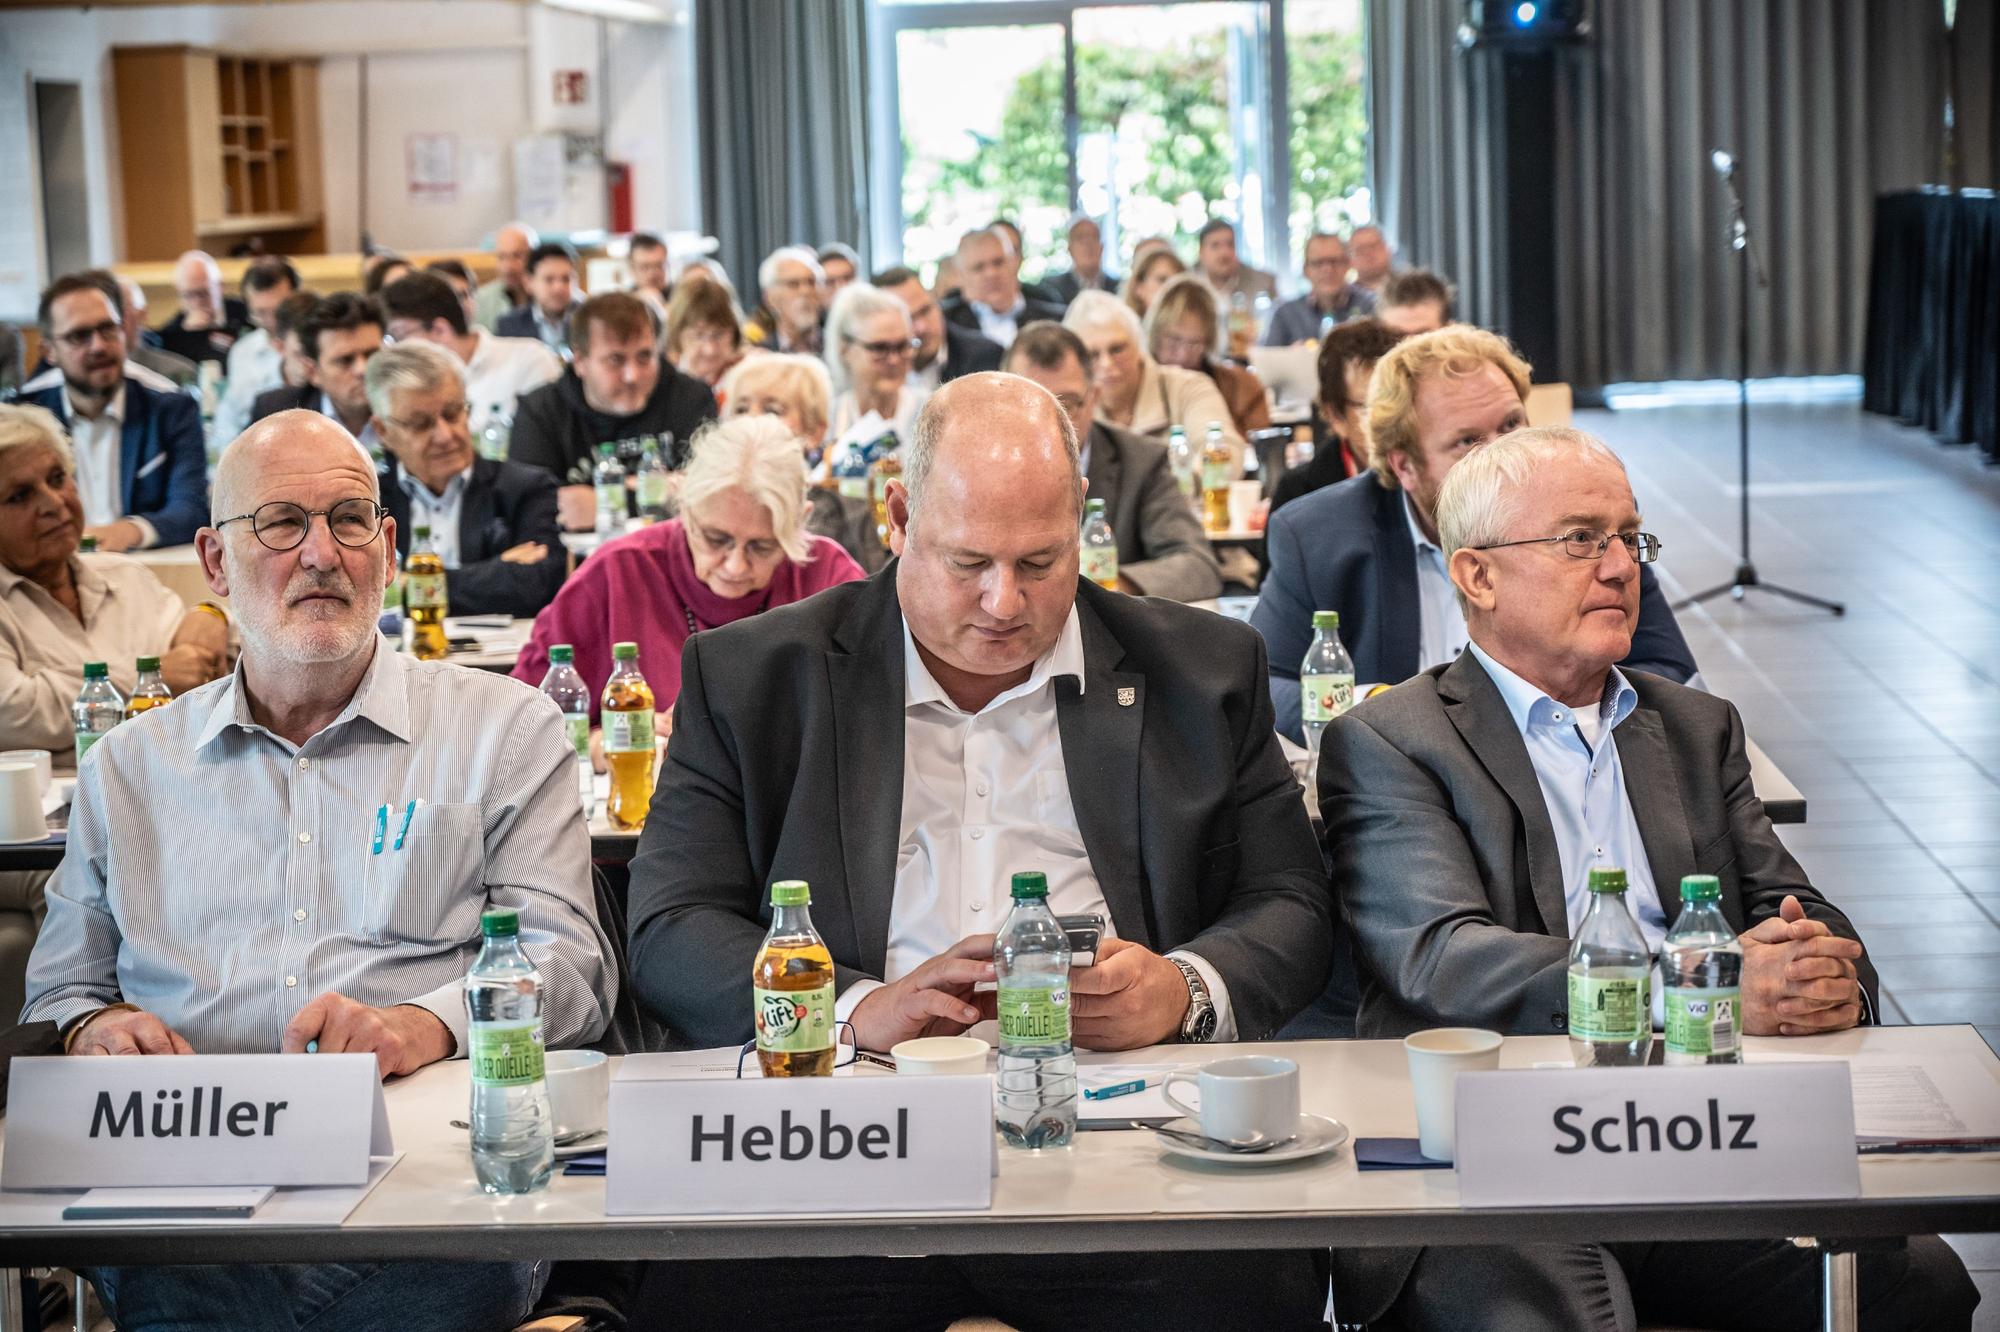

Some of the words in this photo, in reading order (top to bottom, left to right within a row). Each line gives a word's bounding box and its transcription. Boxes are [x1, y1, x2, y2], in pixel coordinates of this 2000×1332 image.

[1016, 1015, 1049, 1037] QUELLE
[496, 1055, 531, 1079] QUELLE
[89, 1087, 288, 1138] Müller
[691, 1107, 908, 1162] Hebbel
[1553, 1098, 1758, 1155] Scholz
